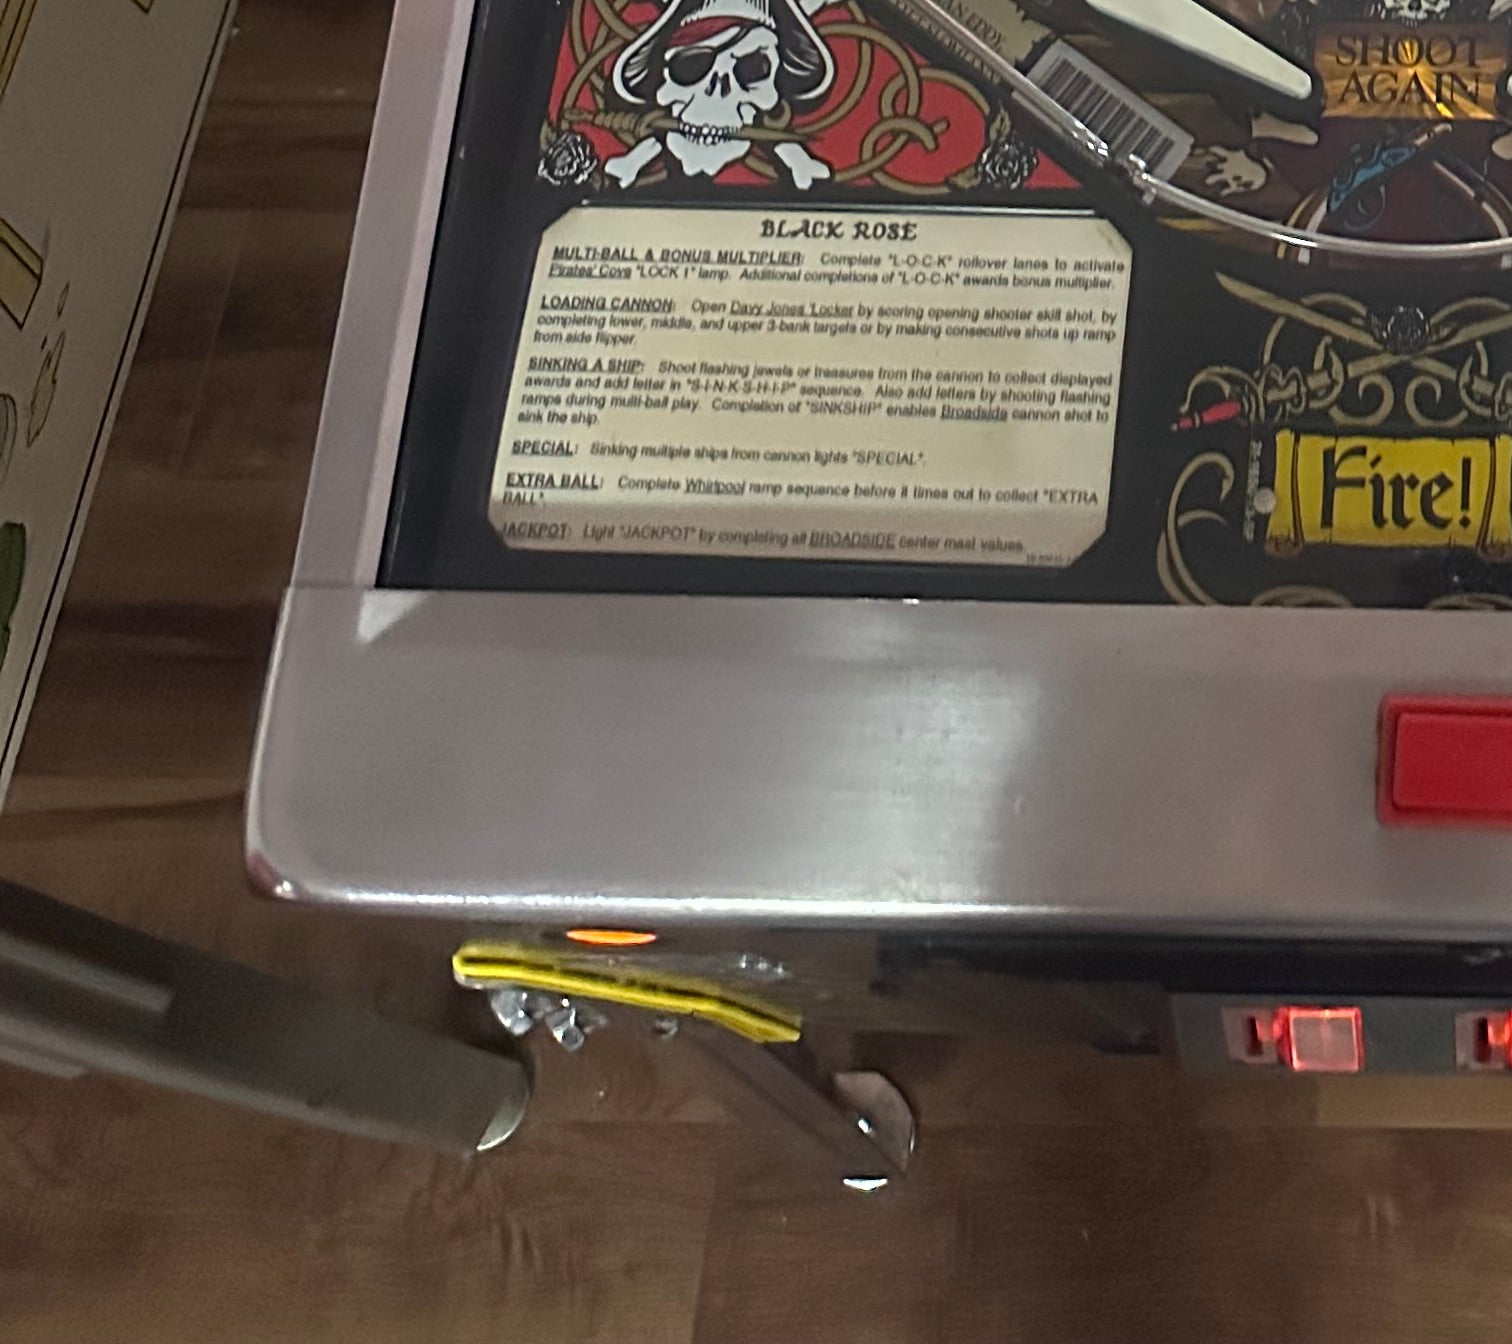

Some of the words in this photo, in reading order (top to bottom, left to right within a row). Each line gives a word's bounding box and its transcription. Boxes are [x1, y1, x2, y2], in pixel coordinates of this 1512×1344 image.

[1334, 33, 1481, 69] SHOOT
[1339, 70, 1481, 106] AGAIN
[759, 219, 845, 241] BLACK
[852, 220, 919, 242] ROSE
[550, 246, 639, 261] MULTI-BALL
[658, 248, 713, 262] BONUS
[715, 249, 806, 264] MULTIPLIER:
[818, 251, 883, 268] Complete
[957, 254, 1008, 268] rollover
[1011, 255, 1049, 269] lanes
[1072, 256, 1125, 270] activate
[596, 265, 634, 278] Cove
[695, 267, 734, 283] lamp.
[738, 268, 803, 281] Additional
[801, 269, 880, 286] completions
[962, 272, 1010, 286] awards
[1010, 273, 1052, 286] bonus
[1053, 274, 1116, 291] multiplier.
[538, 296, 608, 311] LOADING
[608, 297, 678, 312] CANNON:
[688, 299, 728, 316] Open
[728, 300, 764, 317] Davy
[768, 300, 806, 315] Jones
[875, 303, 926, 320] scoring
[926, 304, 981, 322] opening
[982, 305, 1033, 320] shooter
[1035, 306, 1063, 321] skill
[1063, 307, 1098, 324] shot,
[531, 331, 564, 344] from
[563, 332, 594, 345] side
[592, 332, 639, 349] flipper.
[534, 314, 608, 332] completing
[606, 315, 648, 332] lower,
[648, 316, 698, 334] middle,
[698, 317, 726, 331] and
[725, 321, 764, 335] upper
[765, 319, 811, 333] 3-bank
[811, 320, 858, 337] targets
[893, 321, 943, 339] making
[943, 323, 1022, 338] consecutive
[1023, 324, 1060, 339] shots
[1081, 329, 1116, 343] ramp
[526, 356, 590, 371] SINKING
[605, 358, 646, 372] SHIP:
[656, 359, 698, 374] Shoot
[697, 360, 751, 378] flashing
[812, 363, 875, 378] treasures
[876, 364, 909, 379] from
[909, 365, 933, 380] the
[935, 369, 984, 381] cannon
[1004, 367, 1047, 382] collect
[1049, 368, 1114, 387] displayed
[515, 411, 545, 424] sink
[544, 412, 569, 425] the
[568, 412, 603, 429] ship.
[518, 395, 563, 410] ramps
[562, 393, 608, 411] during
[608, 395, 670, 410] multi-ball
[669, 396, 704, 414] play.
[709, 397, 785, 416] Completion
[804, 400, 883, 416] "SINKSHIP"
[884, 402, 938, 417] enables
[939, 403, 1009, 419] Broadside
[1010, 408, 1061, 421] cannon
[1063, 406, 1094, 422] shot
[509, 440, 580, 455] SPECIAL:
[587, 442, 639, 460] Sinking
[638, 444, 693, 461] multiple
[691, 445, 730, 462] ships
[729, 446, 761, 460] from
[761, 450, 811, 462] cannon
[812, 449, 849, 466] lights
[503, 472, 557, 487] EXTRA
[558, 473, 605, 489] BALL:
[615, 475, 682, 494] Complete
[682, 477, 747, 496] Whirlpool
[747, 482, 783, 497] ramp
[784, 483, 851, 499] sequence
[852, 482, 897, 498] before
[911, 484, 949, 499] times
[951, 485, 975, 500] out
[994, 487, 1039, 502] collect
[1041, 488, 1098, 504] "EXTRA
[1320, 443, 1476, 530] Fire!
